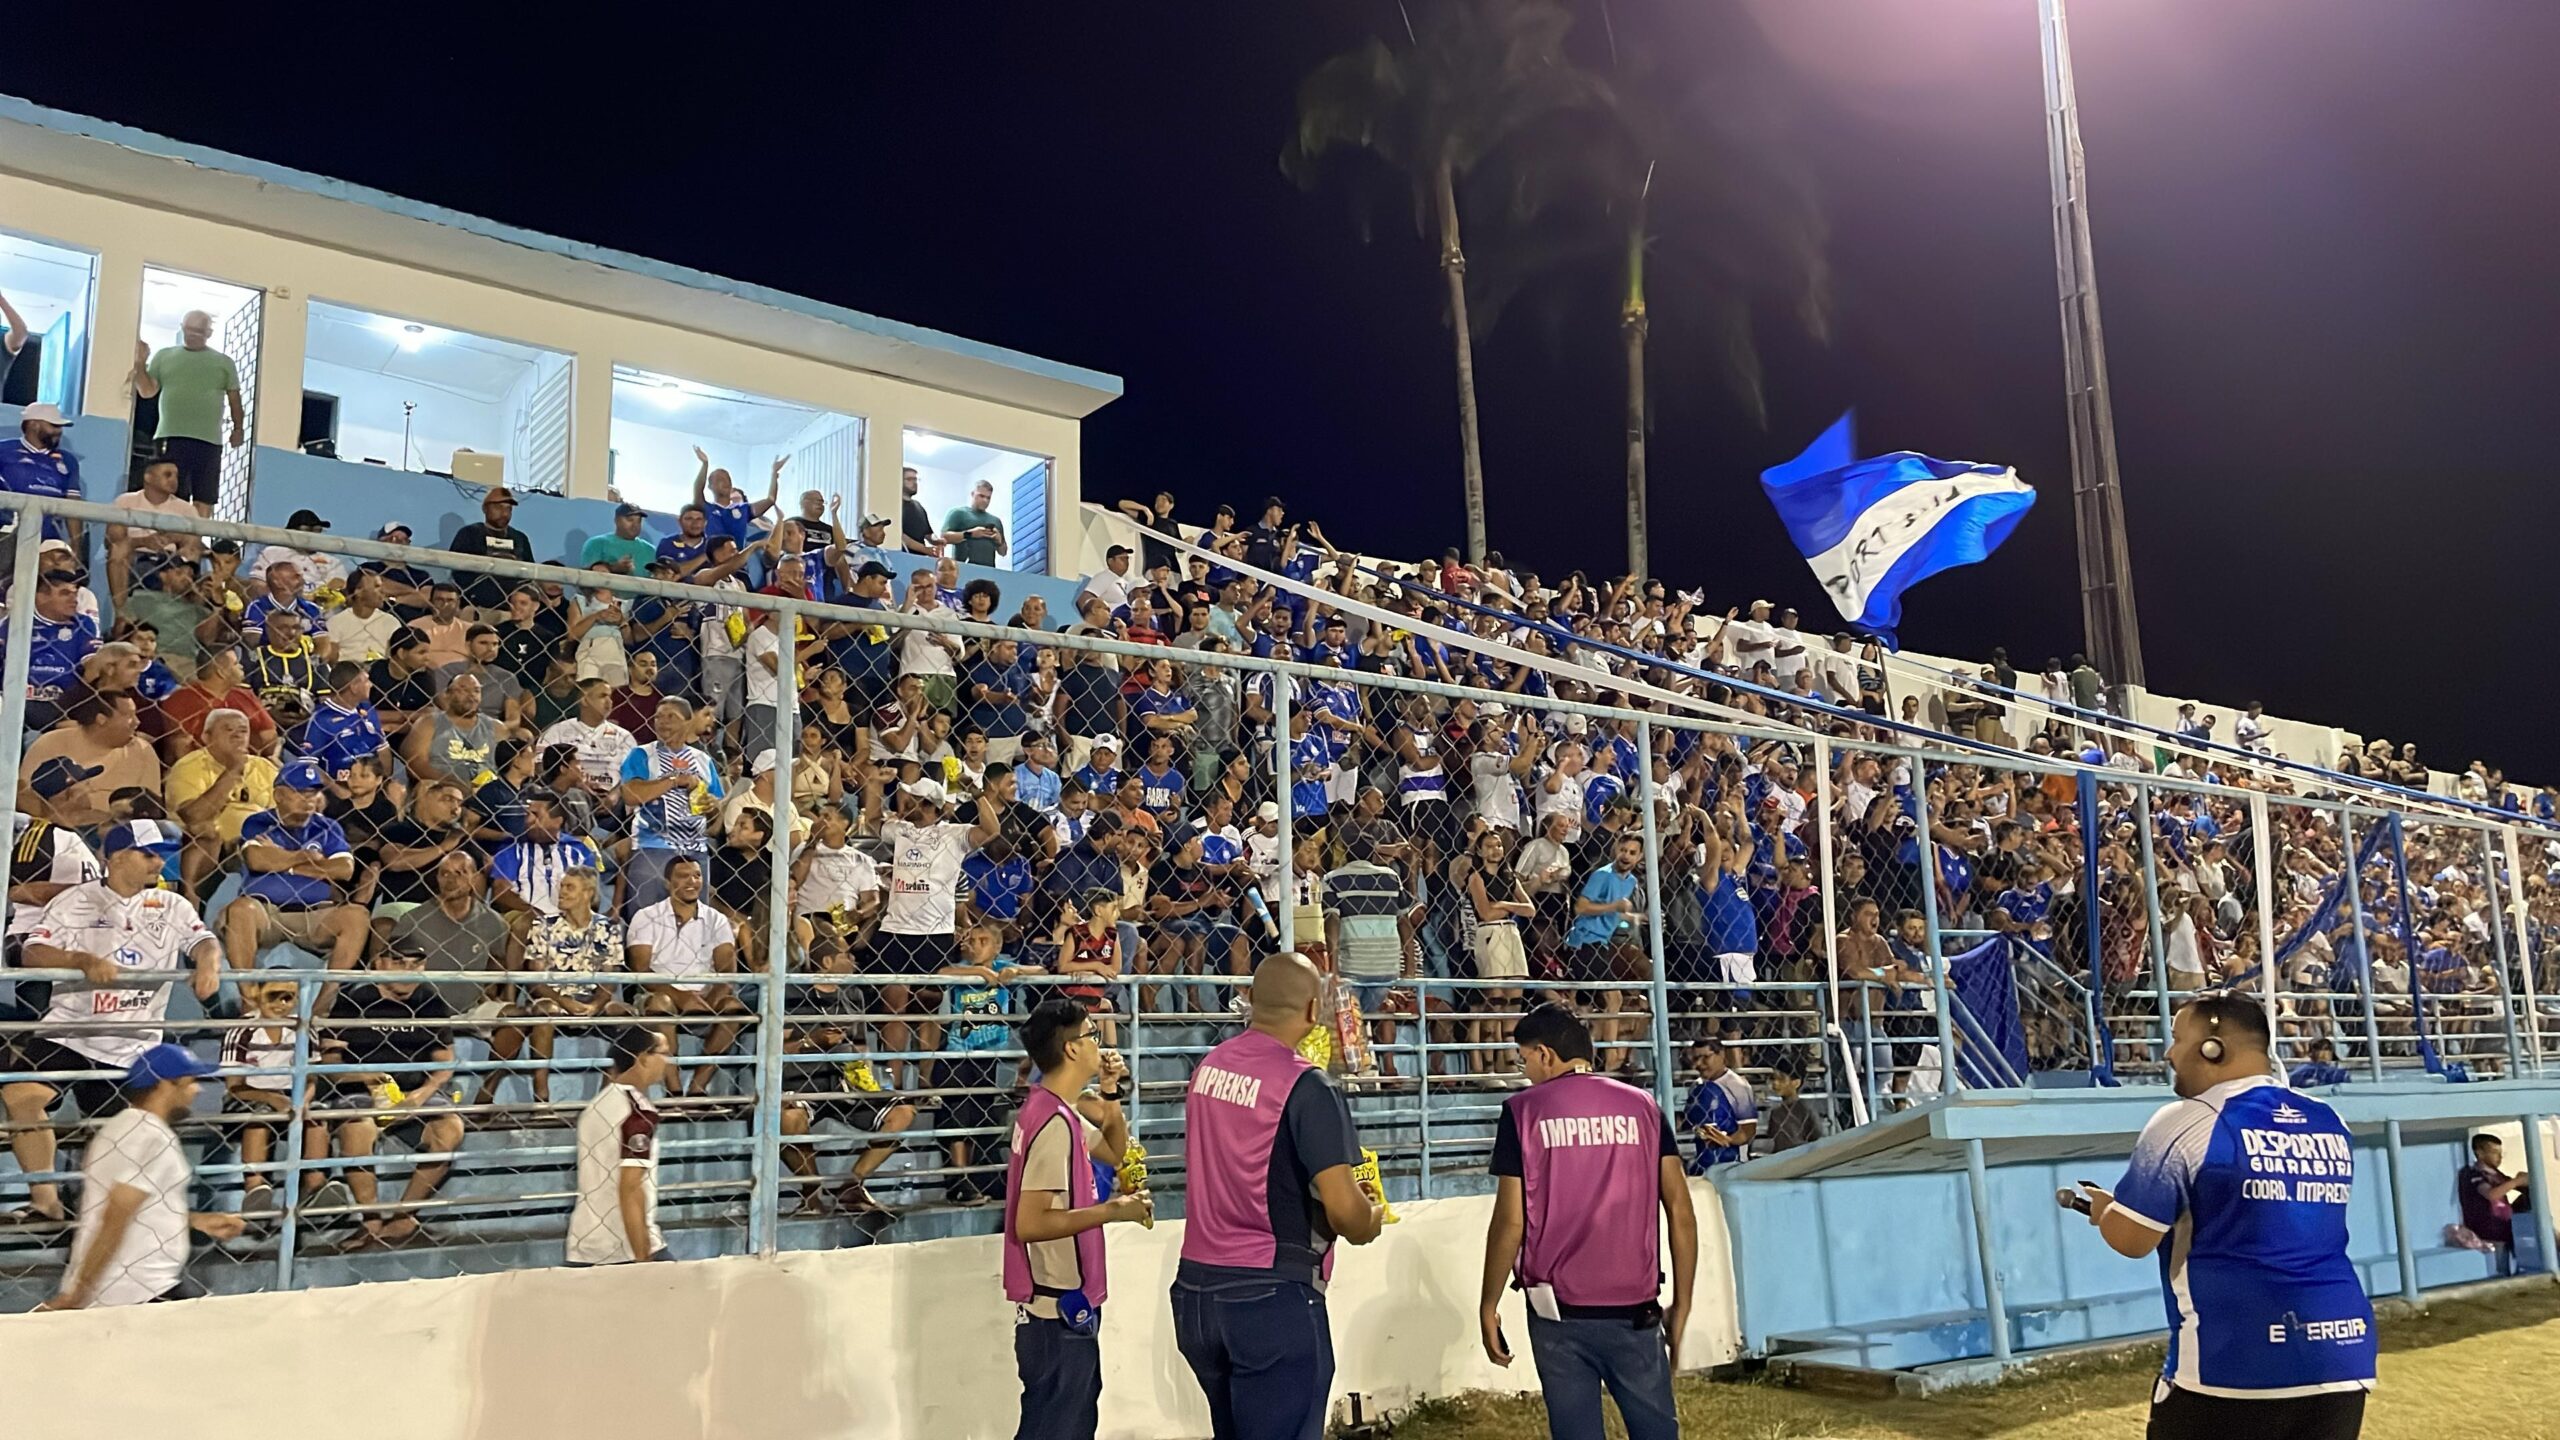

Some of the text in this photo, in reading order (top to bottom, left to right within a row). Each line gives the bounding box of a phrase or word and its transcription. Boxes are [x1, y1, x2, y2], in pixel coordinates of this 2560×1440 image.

[1193, 1065, 1262, 1109] MPRENSA
[1540, 1115, 1640, 1149] IMPRENSA
[2242, 1179, 2351, 1204] COORD. IMPRENS
